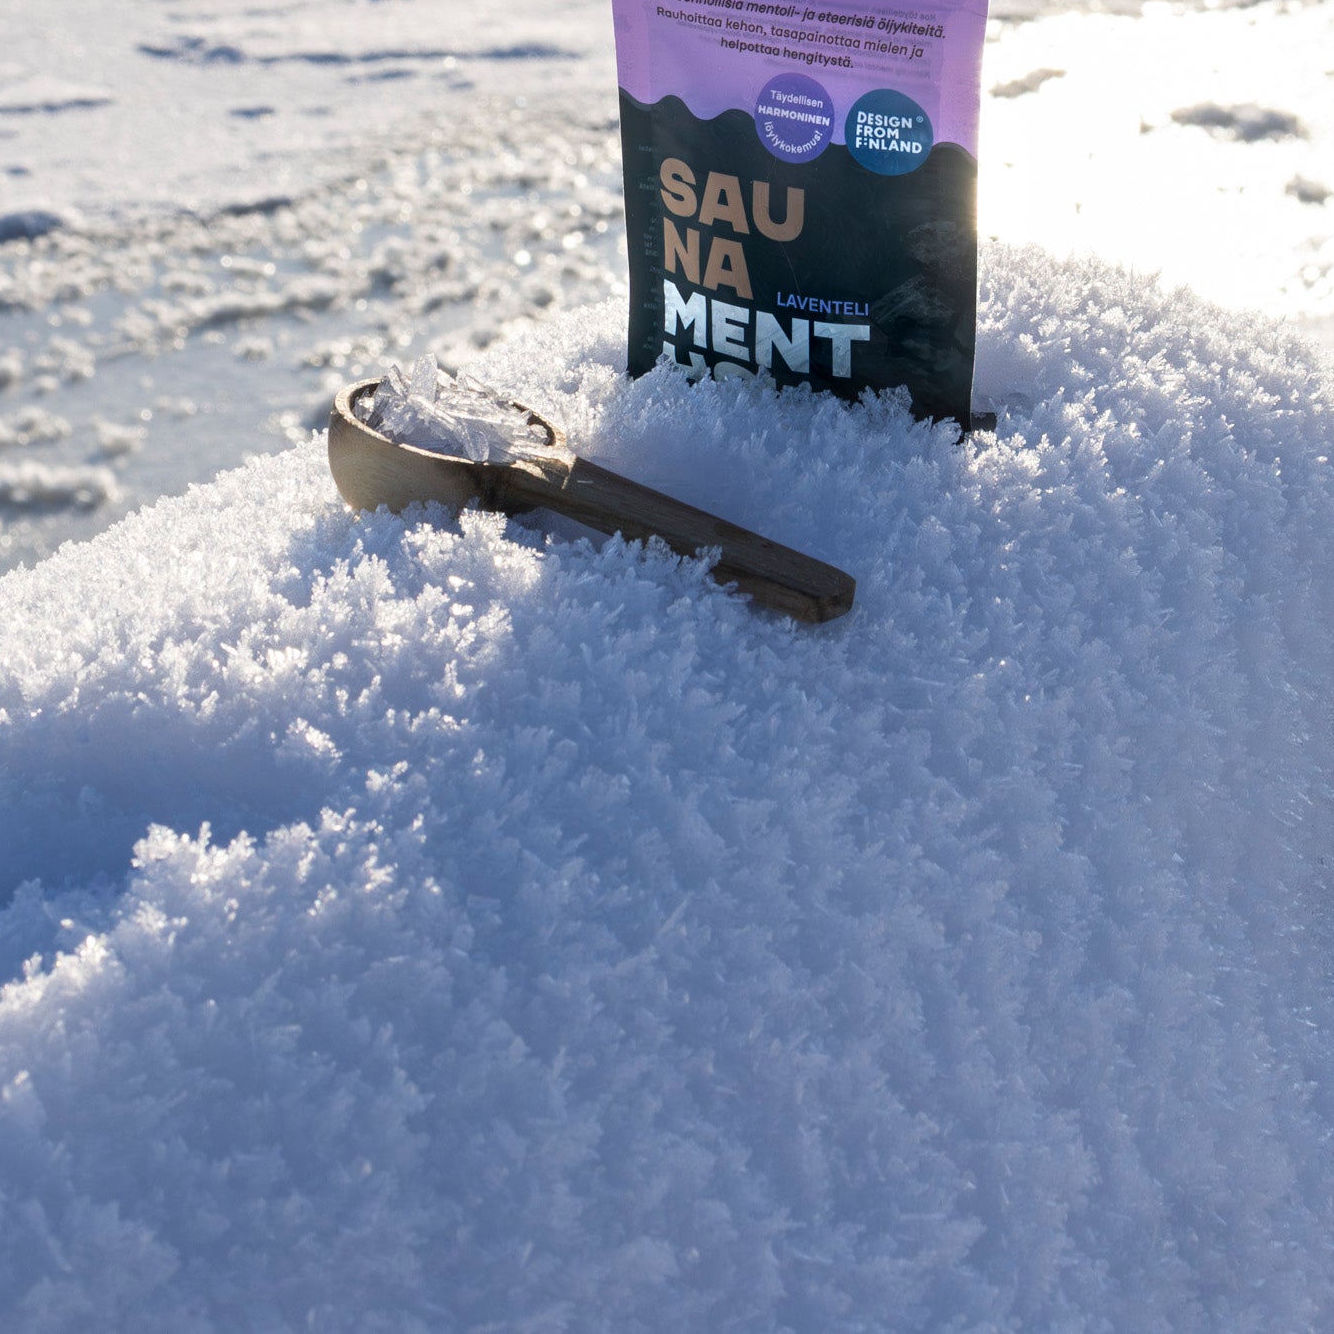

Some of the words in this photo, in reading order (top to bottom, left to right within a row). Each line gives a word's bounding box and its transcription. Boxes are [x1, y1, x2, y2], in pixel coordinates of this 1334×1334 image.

[656, 6, 723, 27] Rauhoittaa
[725, 18, 767, 36] kehon,
[770, 25, 861, 49] tasapainottaa
[863, 39, 908, 55] mielen
[909, 44, 925, 59] ja
[746, 1, 800, 18] mentoli-
[801, 7, 816, 22] ja
[817, 11, 876, 28] eteerisiä
[877, 18, 946, 39] öljykiteitä.
[720, 37, 780, 56] helpottaa
[783, 46, 854, 69] hengitystä.
[758, 104, 831, 126] HARMONINEN
[770, 89, 824, 109] Täydellisen
[856, 124, 900, 140] FROM
[857, 111, 913, 129] DESIGN
[763, 121, 823, 154] löylykokemus!
[659, 157, 805, 242] SAU
[663, 216, 754, 301] NA
[776, 291, 870, 316] LAVENTELI
[663, 278, 871, 379] MENT
